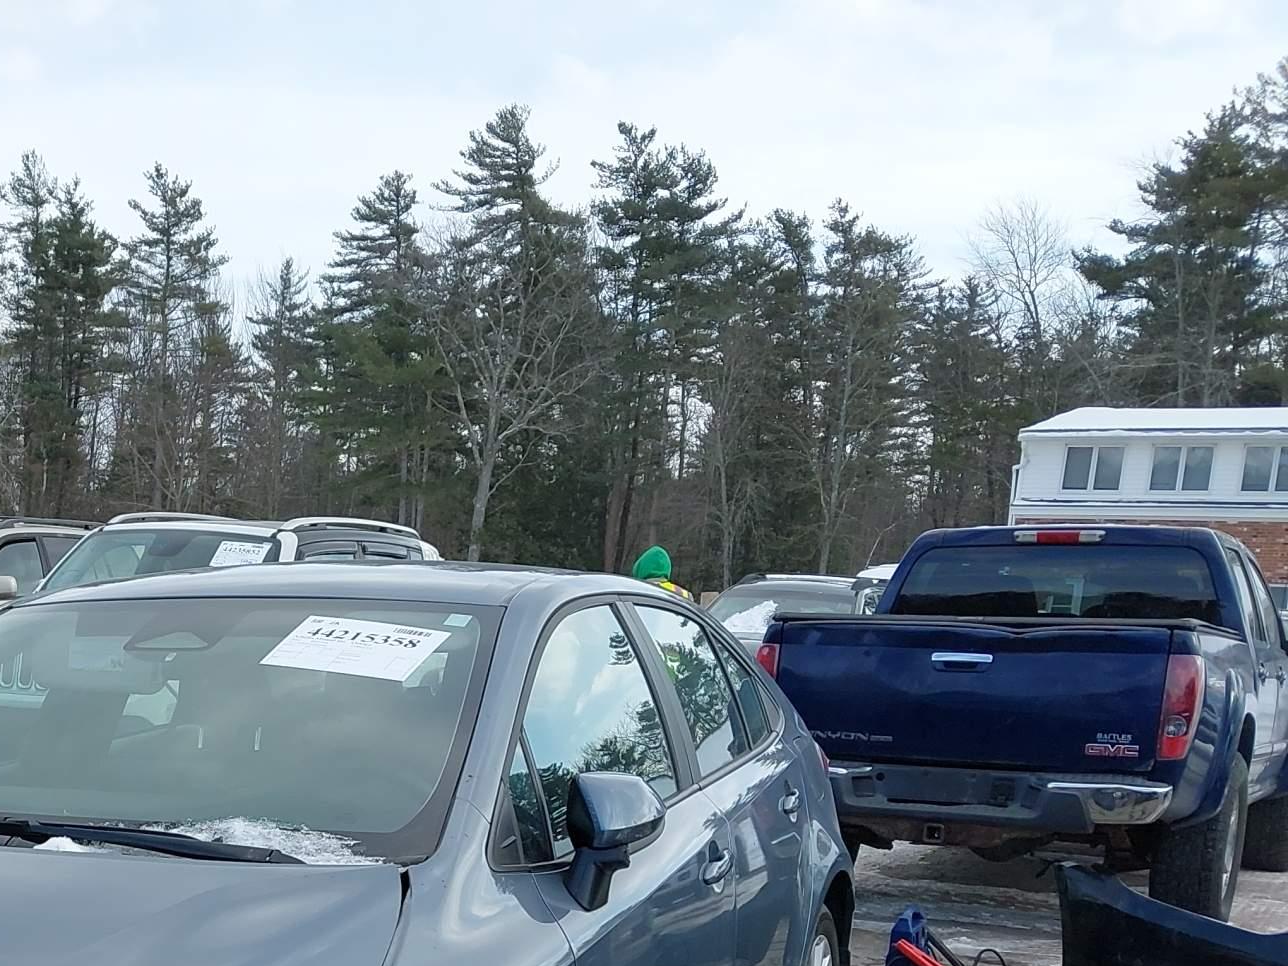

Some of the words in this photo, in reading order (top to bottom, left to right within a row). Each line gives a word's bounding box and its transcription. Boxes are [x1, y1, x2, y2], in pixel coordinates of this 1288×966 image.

[307, 627, 421, 649] 44215358
[808, 730, 869, 741] NYON
[1084, 743, 1139, 757] GMC
